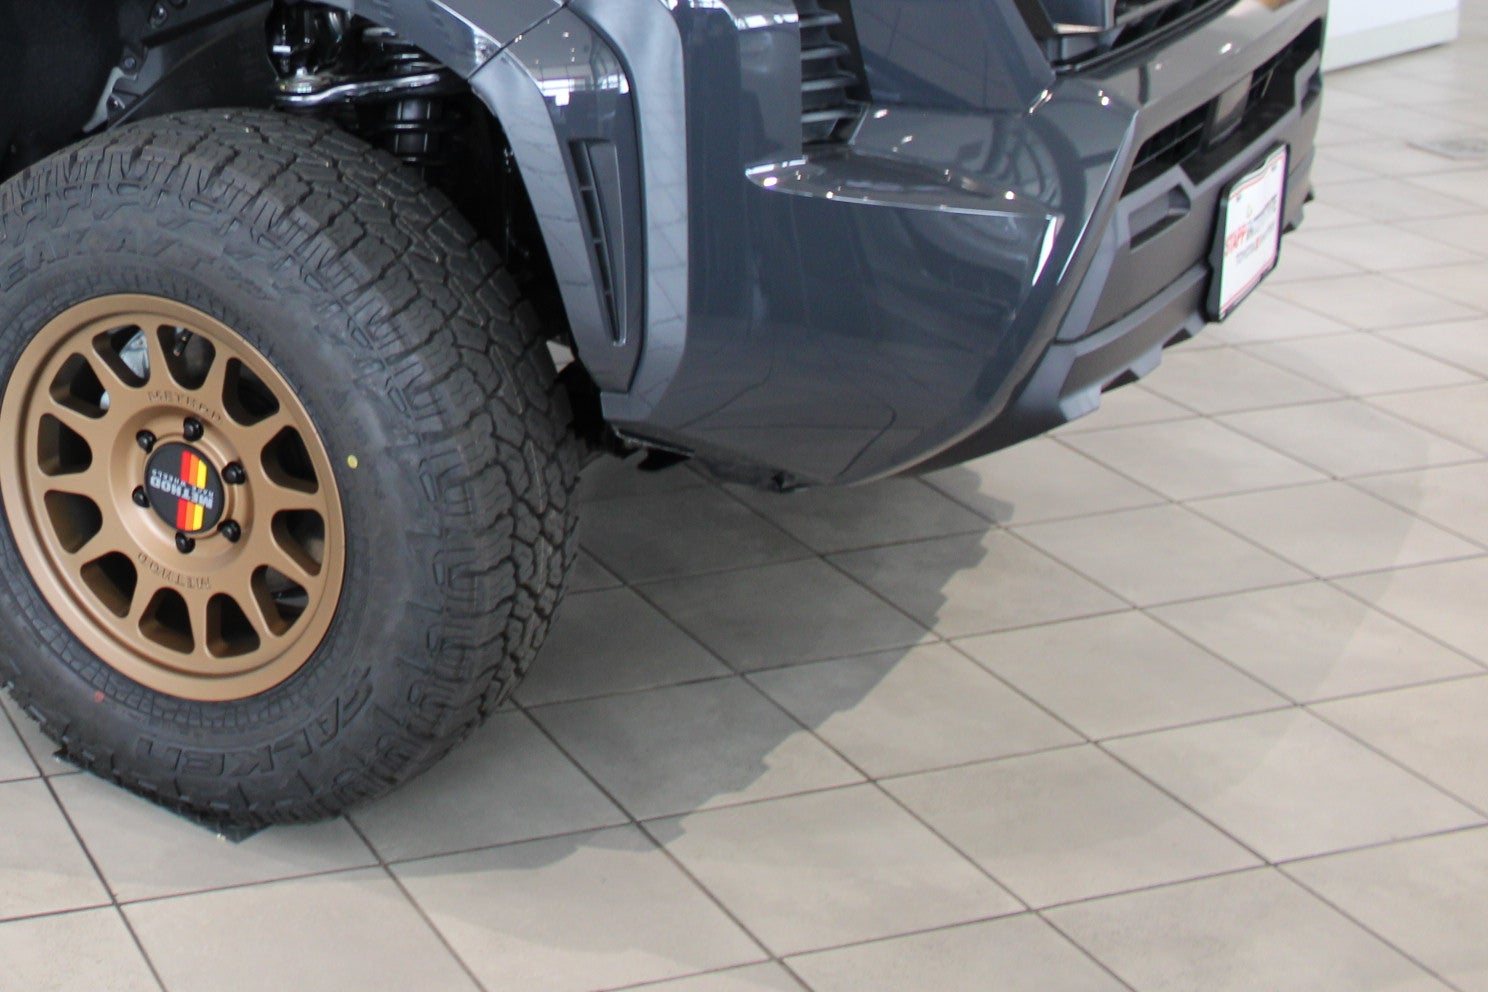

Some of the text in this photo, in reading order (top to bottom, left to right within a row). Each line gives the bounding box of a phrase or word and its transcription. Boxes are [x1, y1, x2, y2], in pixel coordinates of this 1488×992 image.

[147, 390, 224, 425] METHOD
[150, 475, 213, 510] METHOD
[152, 468, 187, 488] WHEELS
[137, 551, 213, 590] METHOD
[136, 665, 374, 777] FALKEN
